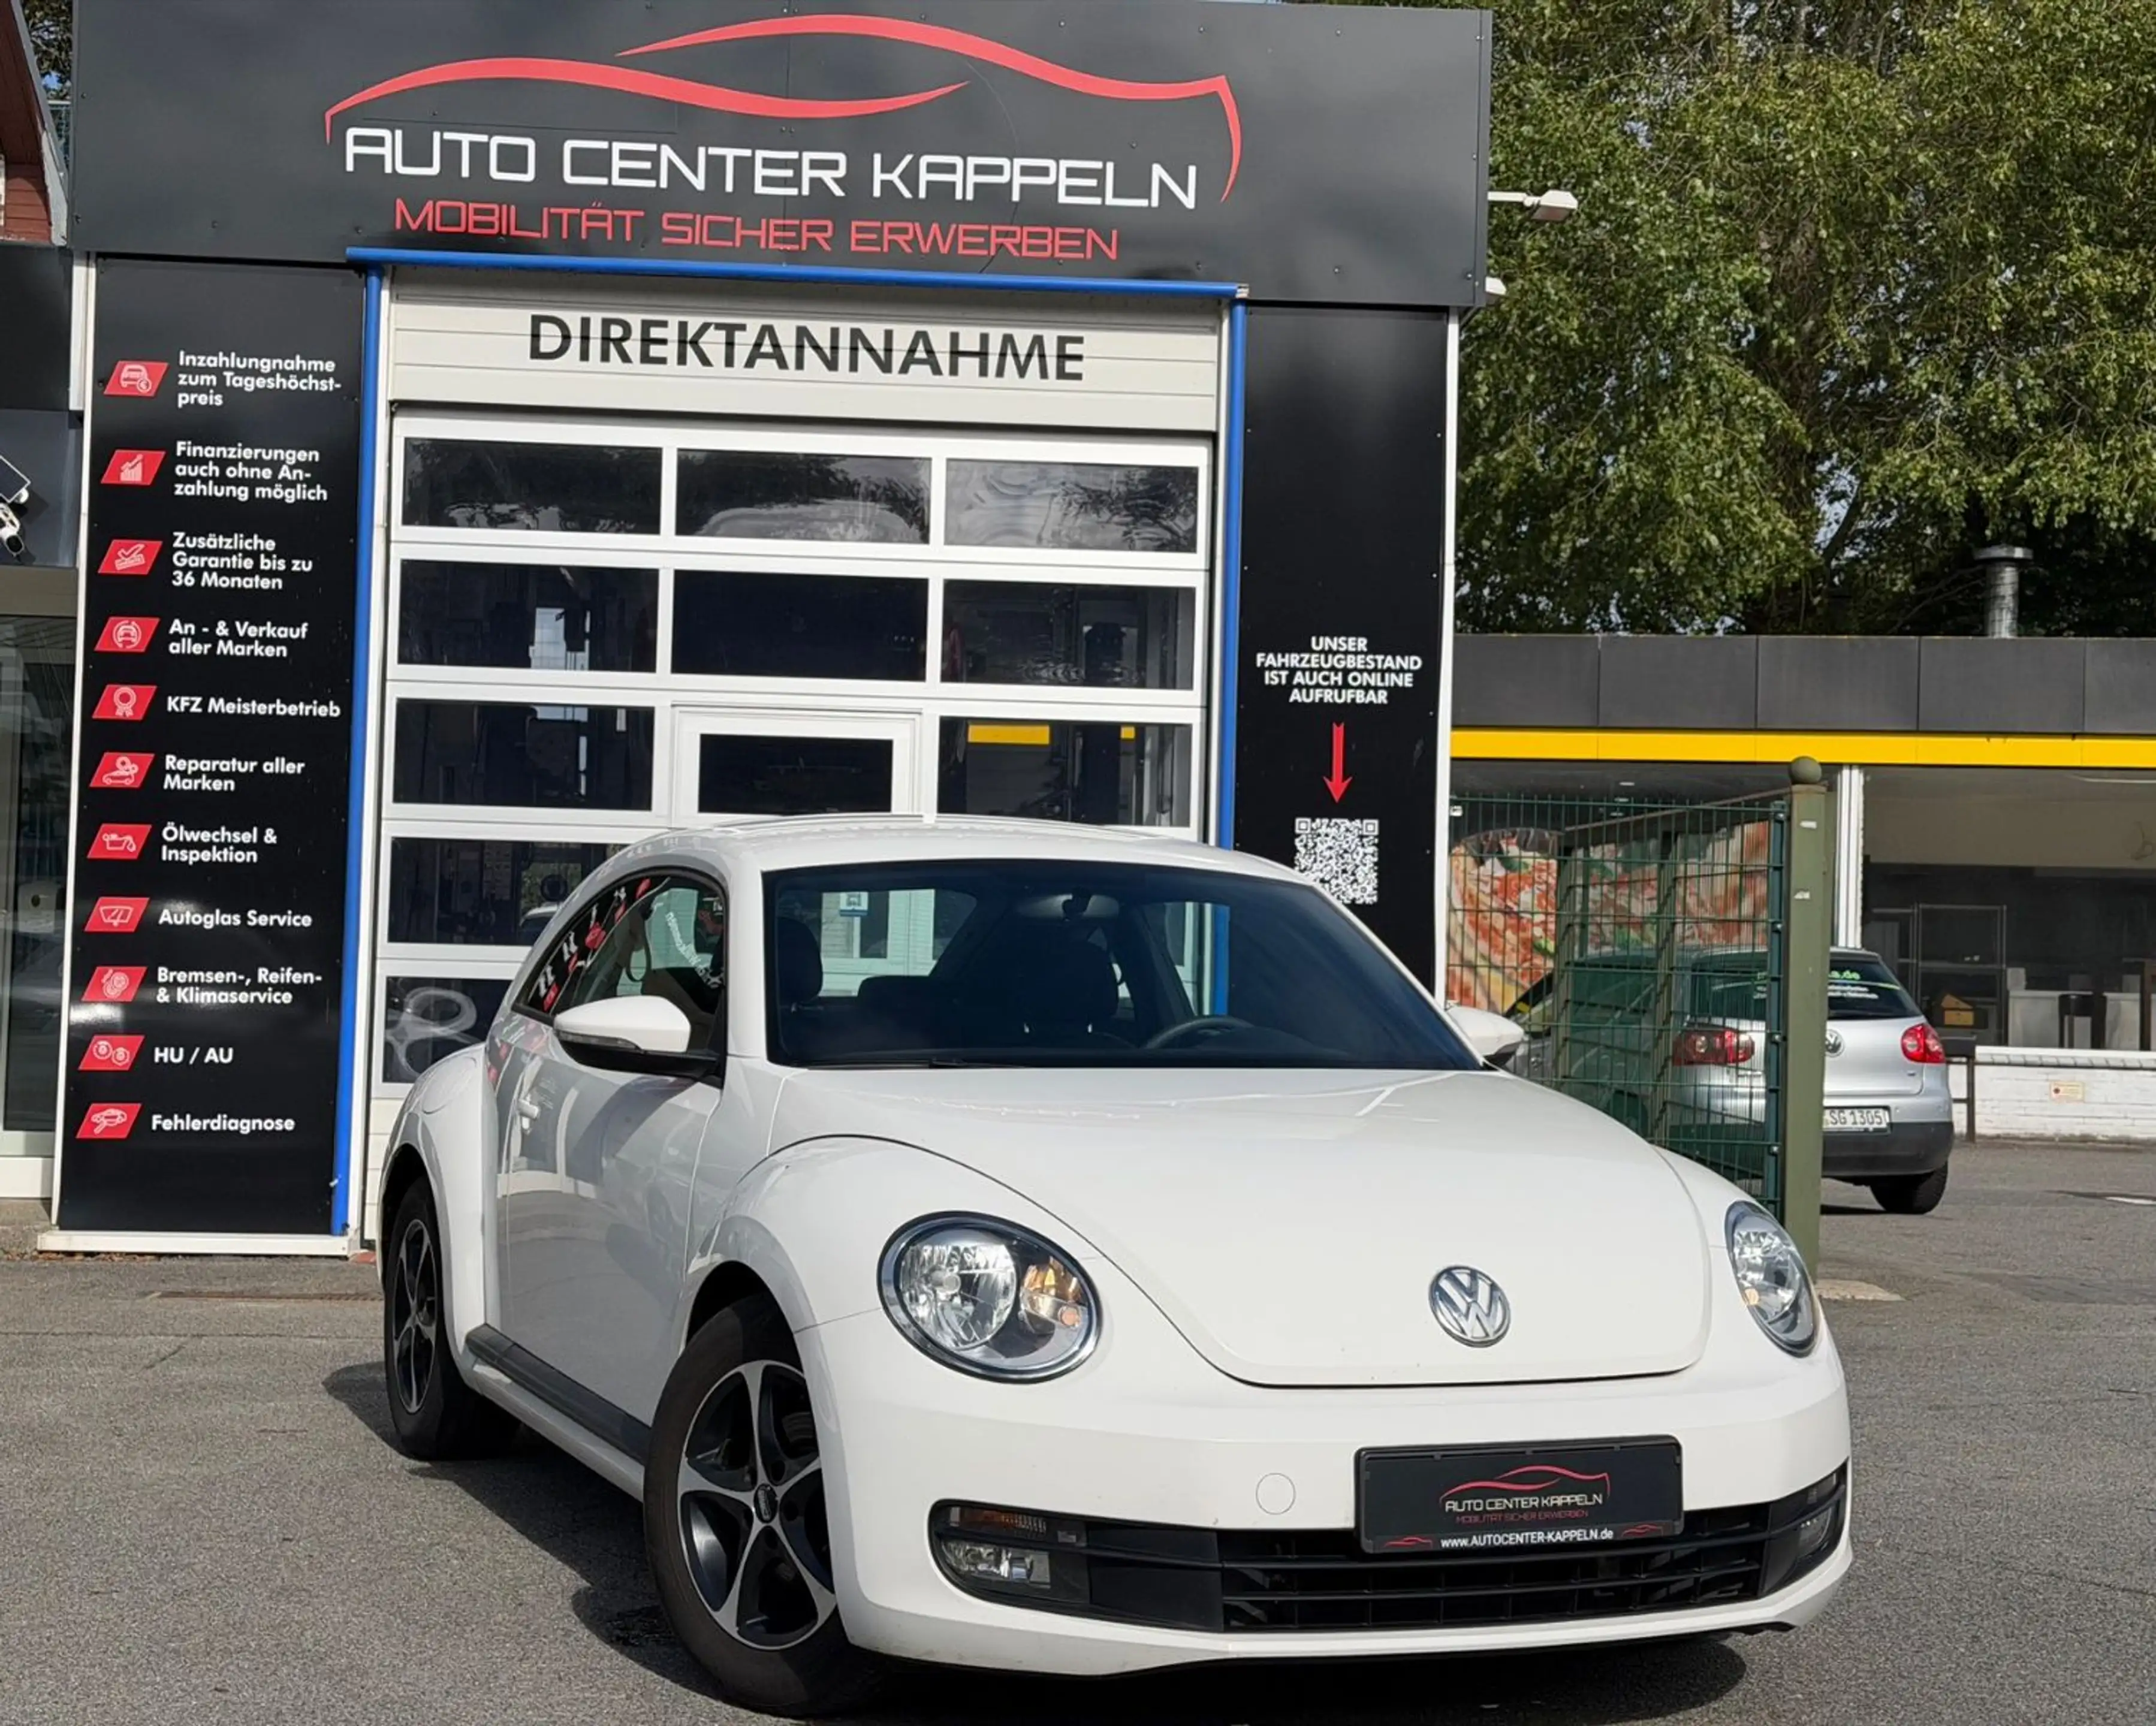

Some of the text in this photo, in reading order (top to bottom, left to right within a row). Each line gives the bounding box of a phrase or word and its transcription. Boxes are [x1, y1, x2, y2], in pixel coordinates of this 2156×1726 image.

[346, 127, 1196, 209] AUTO CENTER KAPPELN
[394, 198, 1118, 260] MOBILITÄT SICHER ERWERBEN
[530, 314, 1085, 381] DIREKTANNAHME
[179, 351, 336, 373] Inzahlungnahme
[179, 372, 341, 391] zum Tageshöchst-
[178, 390, 223, 408] preis
[176, 441, 319, 463] Finanzierungen
[176, 460, 310, 481] auch ohne An-
[174, 481, 327, 503] zahlung möglich
[173, 532, 276, 551] Zusätzliche
[173, 552, 312, 571] Garantie bis zu
[172, 571, 282, 590] 36 Monaten
[169, 619, 195, 635] An
[215, 621, 228, 636] &
[235, 621, 308, 639] Verkauf
[169, 638, 287, 657] aller Marken
[1311, 636, 1367, 651] UNSER
[1256, 653, 1422, 670] FAHRZEUGBESTAND
[1265, 671, 1413, 687] IST AUCH ONLINE
[1289, 689, 1388, 704] AUFRUFBAR
[167, 696, 340, 717] KFZ Meisterbetrieb
[165, 755, 304, 774] Reparatur aller
[164, 774, 234, 791] Marken
[162, 822, 277, 844] Ölwechsel &
[162, 846, 257, 865] Inspektion
[159, 909, 312, 928] Autoglas Service
[157, 967, 322, 985] Bremsen-, Reifen-
[156, 988, 293, 1004] & Klimaservice
[154, 1048, 184, 1064] HU
[204, 1048, 233, 1064] AU
[152, 1115, 295, 1134] Fehlerdiagnose
[1829, 1109, 1883, 1125] SG 1305
[1445, 1493, 1603, 1513] AUTO CENTER KAPPELN
[1441, 1528, 1614, 1548] www.AUTOCENTER-KAPPELN.de
